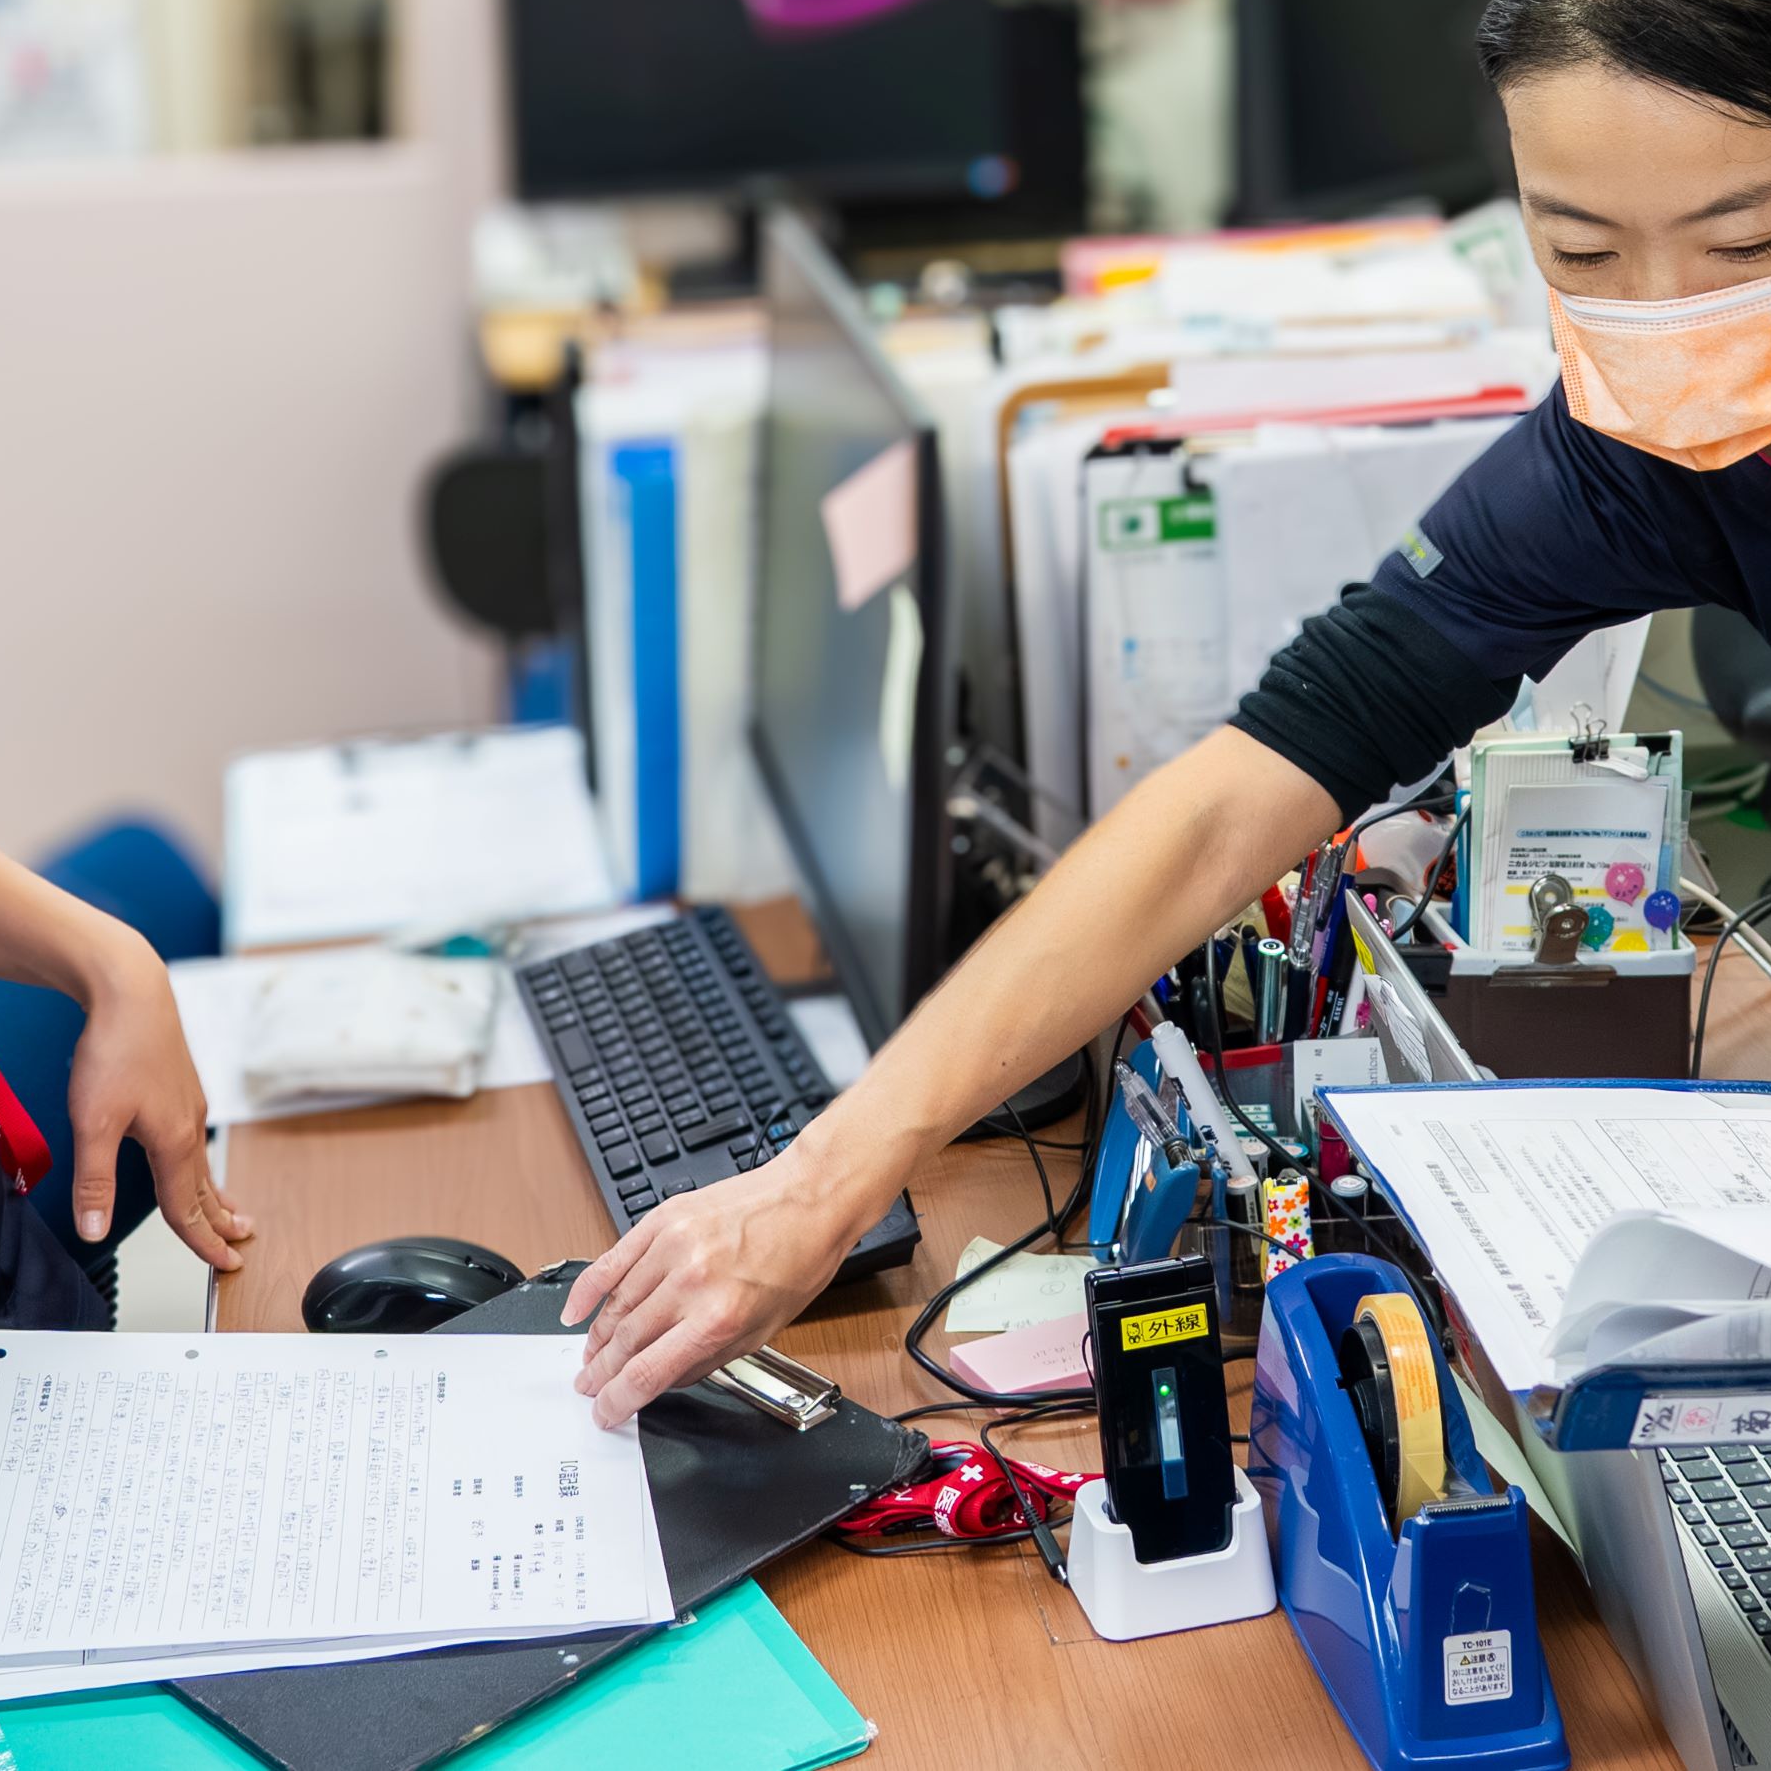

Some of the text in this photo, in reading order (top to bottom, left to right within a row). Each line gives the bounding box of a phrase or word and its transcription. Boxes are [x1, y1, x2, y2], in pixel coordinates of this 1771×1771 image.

[1148, 1313, 1201, 1339] 外線
[558, 1460, 579, 1497] IC記録
[1462, 1638, 1492, 1649] TC-101E
[1471, 1654, 1486, 1663] 注意
